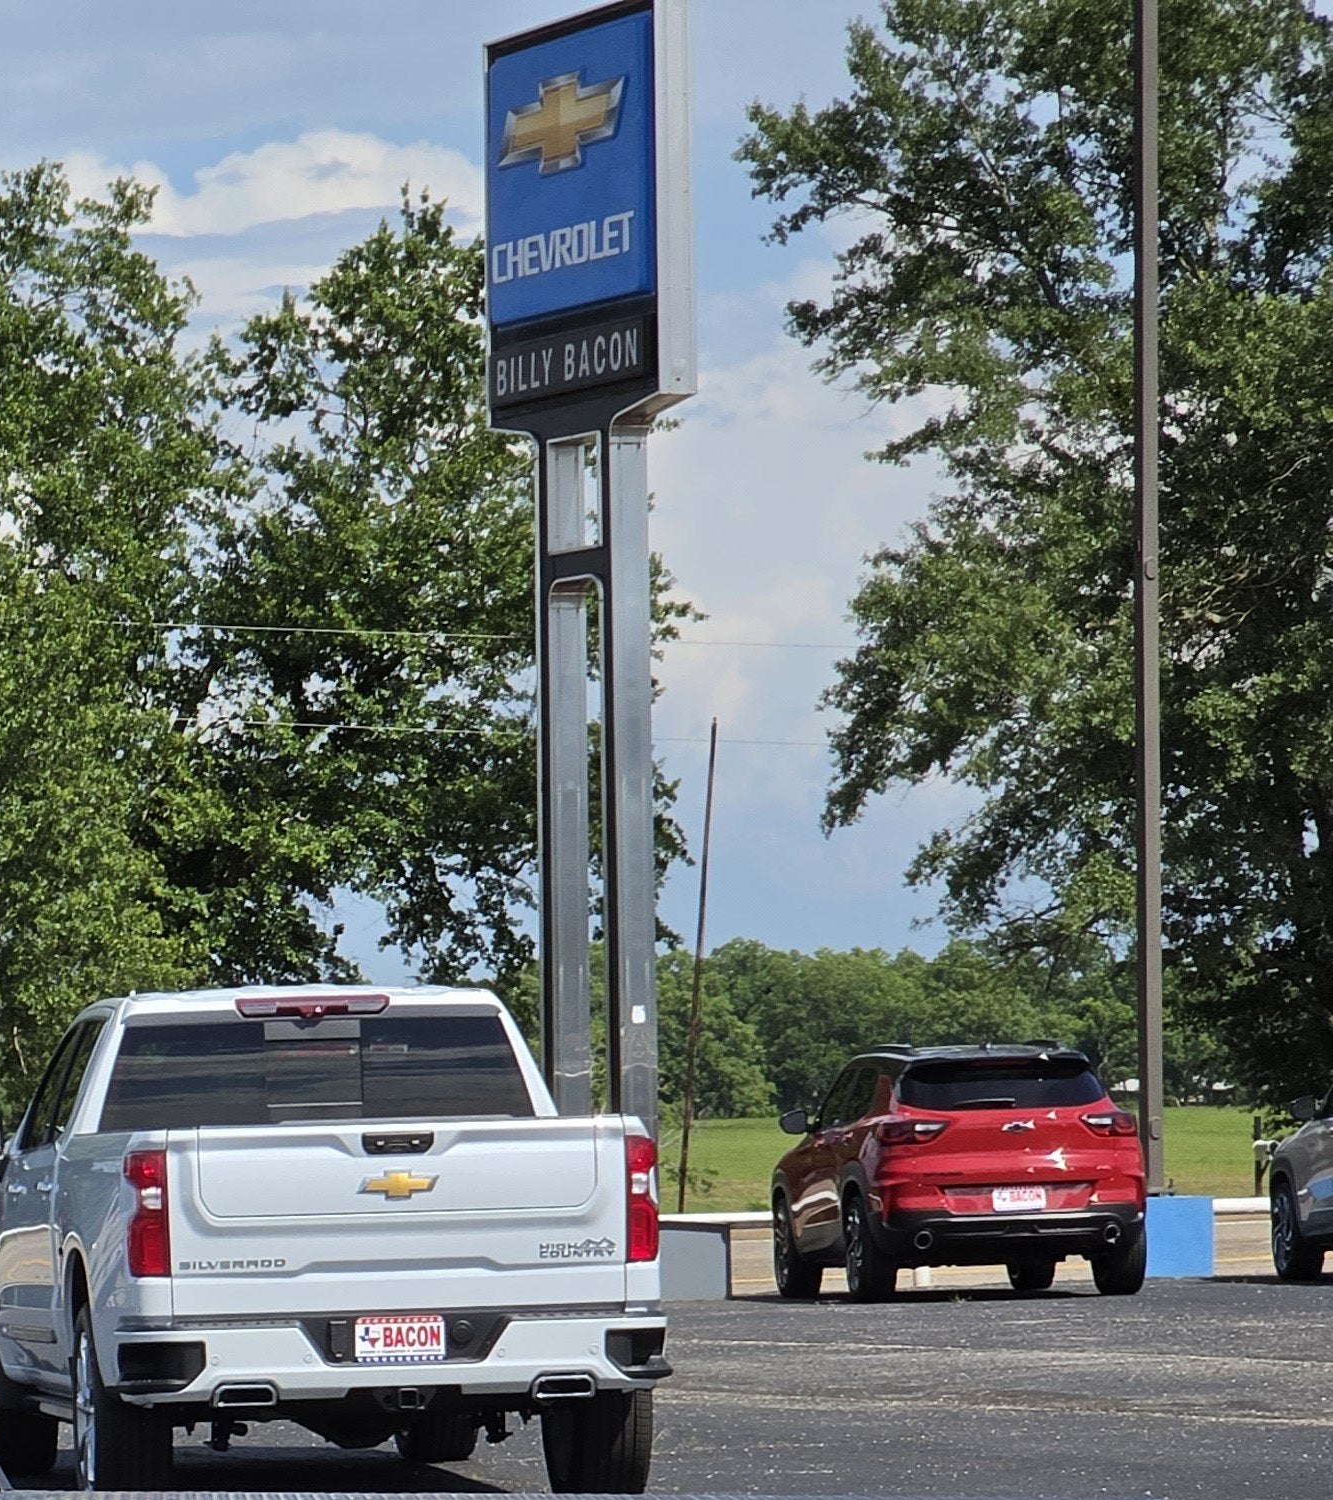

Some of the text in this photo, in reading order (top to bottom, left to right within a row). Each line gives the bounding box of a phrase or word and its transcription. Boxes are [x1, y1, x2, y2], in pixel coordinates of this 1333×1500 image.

[492, 210, 635, 285] CHEVROLET
[496, 327, 640, 397] BILLY BACON
[539, 1242, 577, 1251] HIGH
[539, 1249, 615, 1259] COUNTRY
[178, 1259, 286, 1270] SILVERADO
[382, 1325, 441, 1348] BACON
